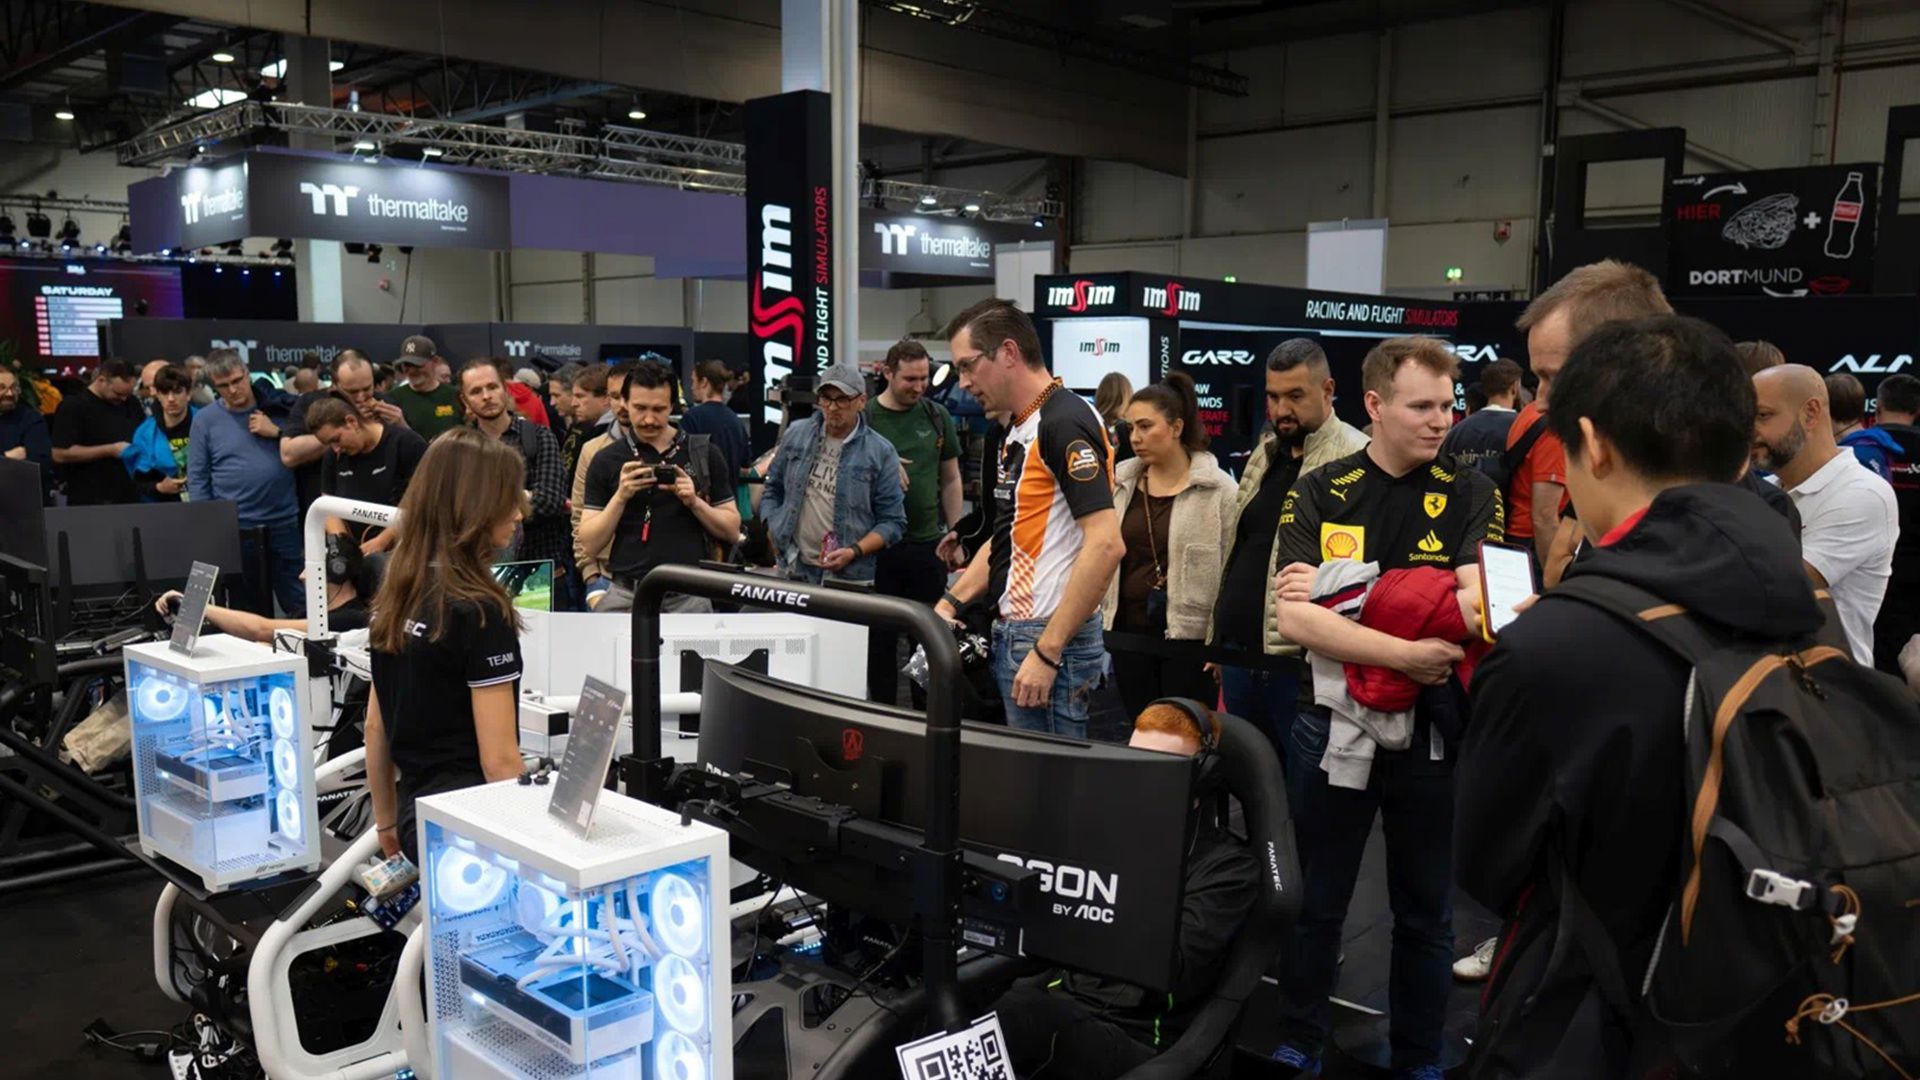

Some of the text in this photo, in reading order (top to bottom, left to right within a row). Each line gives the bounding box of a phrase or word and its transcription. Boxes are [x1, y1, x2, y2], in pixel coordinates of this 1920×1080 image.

[367, 193, 468, 223] thermaltake
[1676, 203, 1721, 221] HIER
[814, 187, 828, 285] SIMULATORS
[920, 232, 990, 258] thermaltake
[1688, 267, 1804, 285] DORTMUND
[41, 285, 113, 296] SATURDAY
[815, 287, 829, 341] FLIGHT
[1306, 300, 1458, 327] RACING AND FLIGHT SIMULATORS
[1161, 336, 1170, 379] TIONS
[1195, 383, 1210, 395] AW
[352, 507, 389, 522] FANATEC
[1408, 553, 1450, 563] Santander
[731, 583, 811, 607] FANATEC
[486, 652, 515, 667] TEAM
[1267, 841, 1283, 891] FANATEC
[1052, 903, 1115, 924] BY AOC
